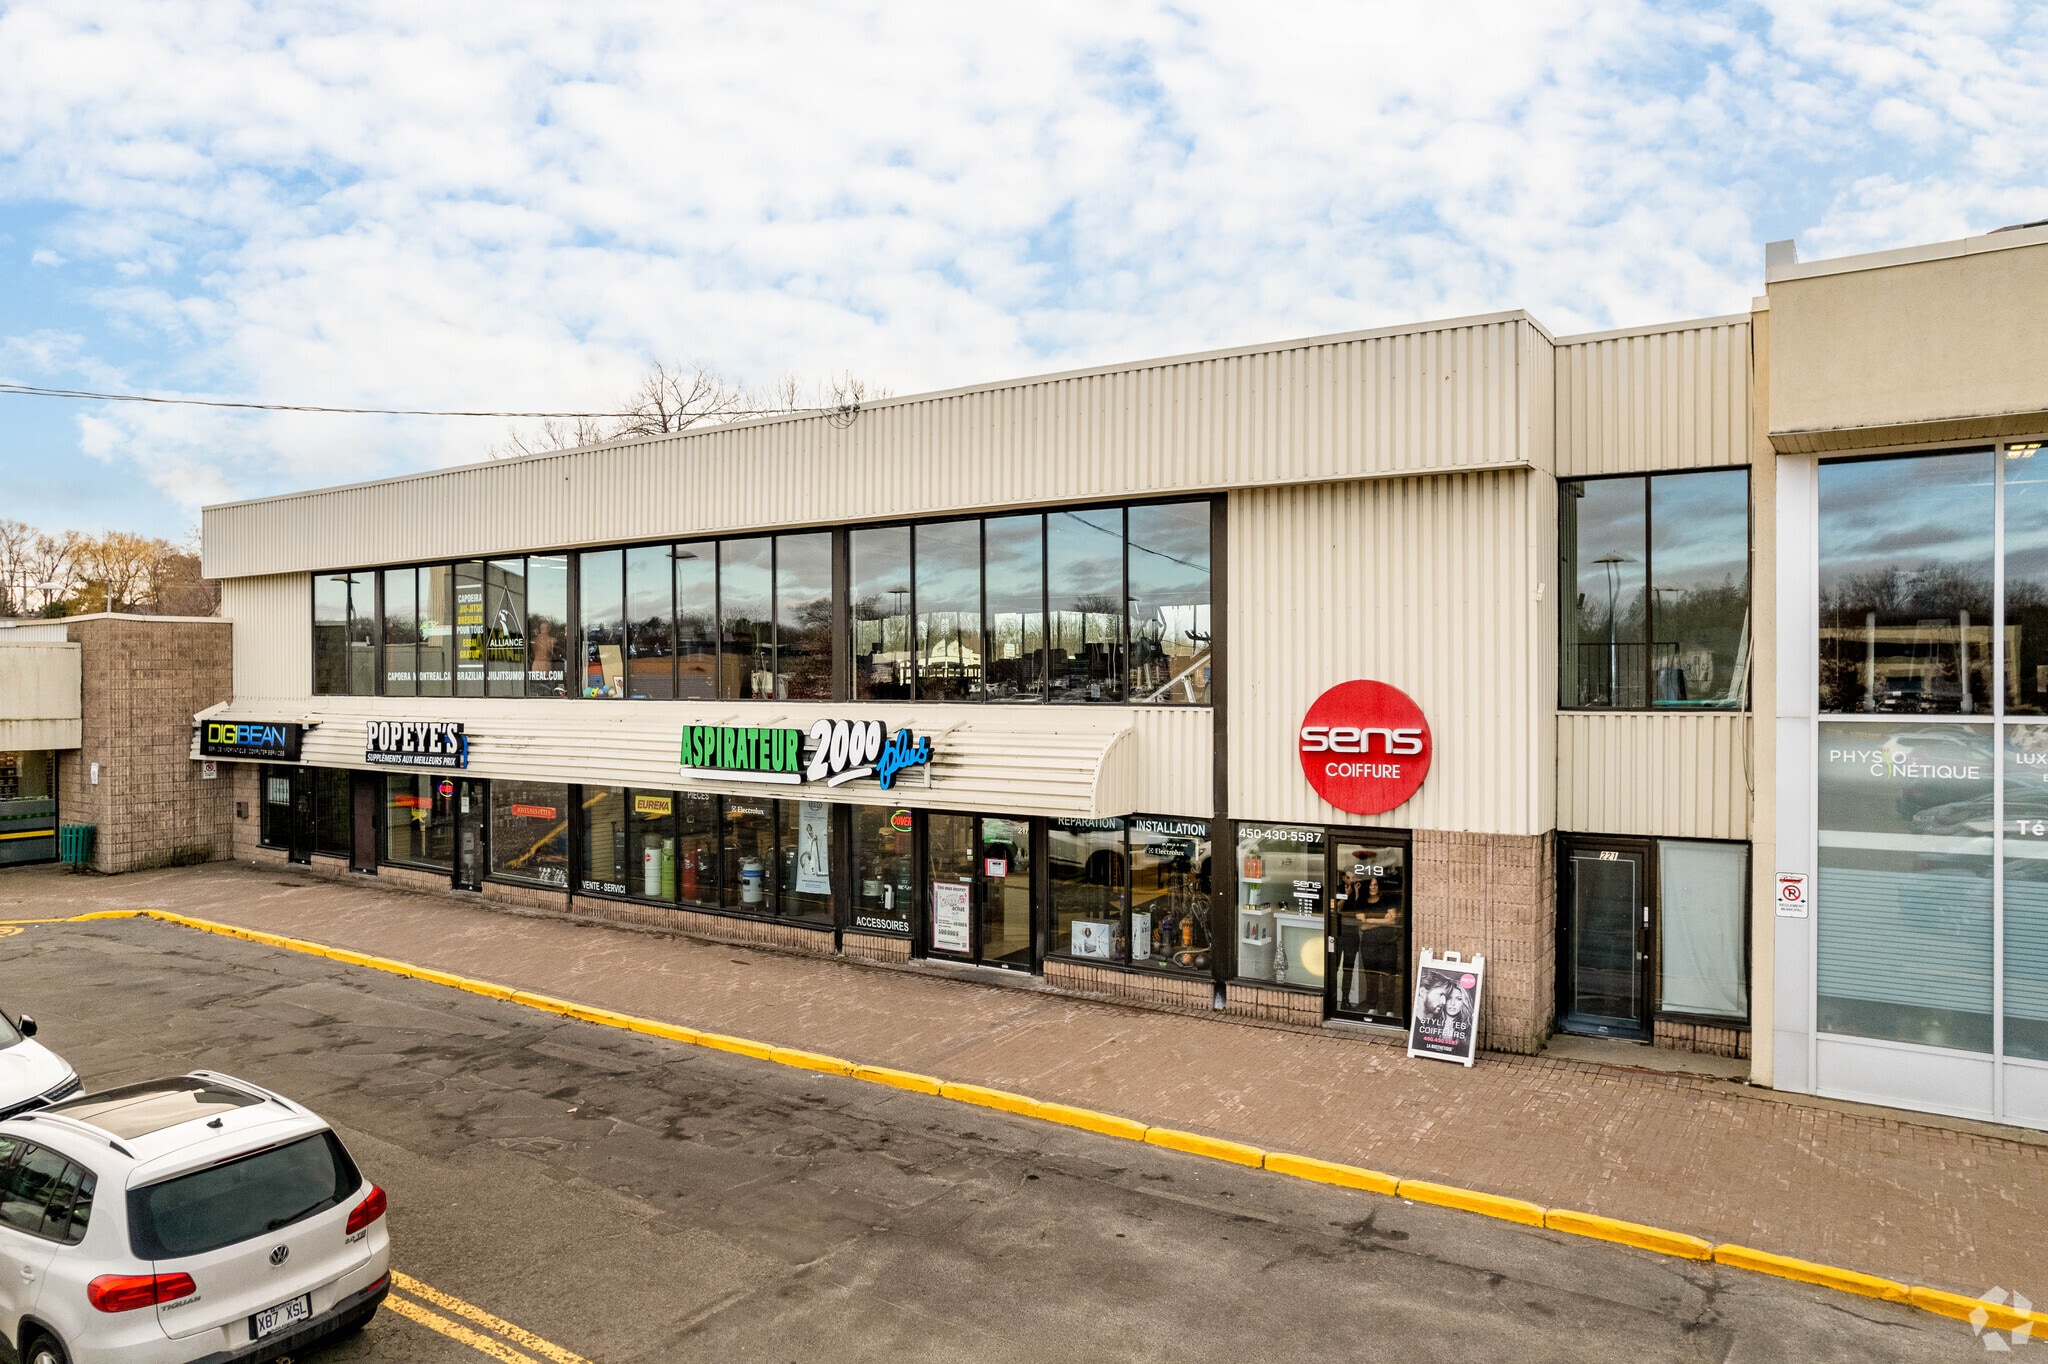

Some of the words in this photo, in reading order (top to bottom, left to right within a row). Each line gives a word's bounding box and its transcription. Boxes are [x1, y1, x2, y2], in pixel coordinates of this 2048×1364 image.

[458, 593, 482, 603] CAPOEIRA
[457, 625, 470, 634] POUR
[471, 625, 484, 634] TOUS
[489, 638, 524, 647] ALLIANCE
[208, 723, 286, 746] DIGIBEAN
[366, 721, 459, 754] POPEYE'S
[1301, 726, 1423, 755] sens
[401, 755, 414, 764] AUX
[413, 755, 442, 766] MEILLEURS
[442, 757, 456, 767] PRIX
[680, 725, 799, 772] ASPIRATEUR
[807, 719, 882, 781] 2000
[876, 728, 929, 790] plus
[1325, 762, 1401, 779] COIFFURE
[637, 799, 670, 811] EUREKA
[737, 806, 764, 815] Electrolux
[1136, 820, 1206, 836] INSTALLATION
[1238, 828, 1322, 843] 450-430-5587
[1155, 847, 1185, 856] Electrolux
[1600, 851, 1618, 861] 221
[1354, 864, 1384, 876] 219
[582, 880, 600, 891] VENTE
[856, 916, 909, 932] ACCESSOIRES
[1420, 1016, 1467, 1030] STYLISTES
[1419, 1026, 1466, 1040] COIFFEURS
[161, 1295, 201, 1311] TIGUAN
[258, 1311, 278, 1332] X87
[286, 1301, 307, 1320] XSL
